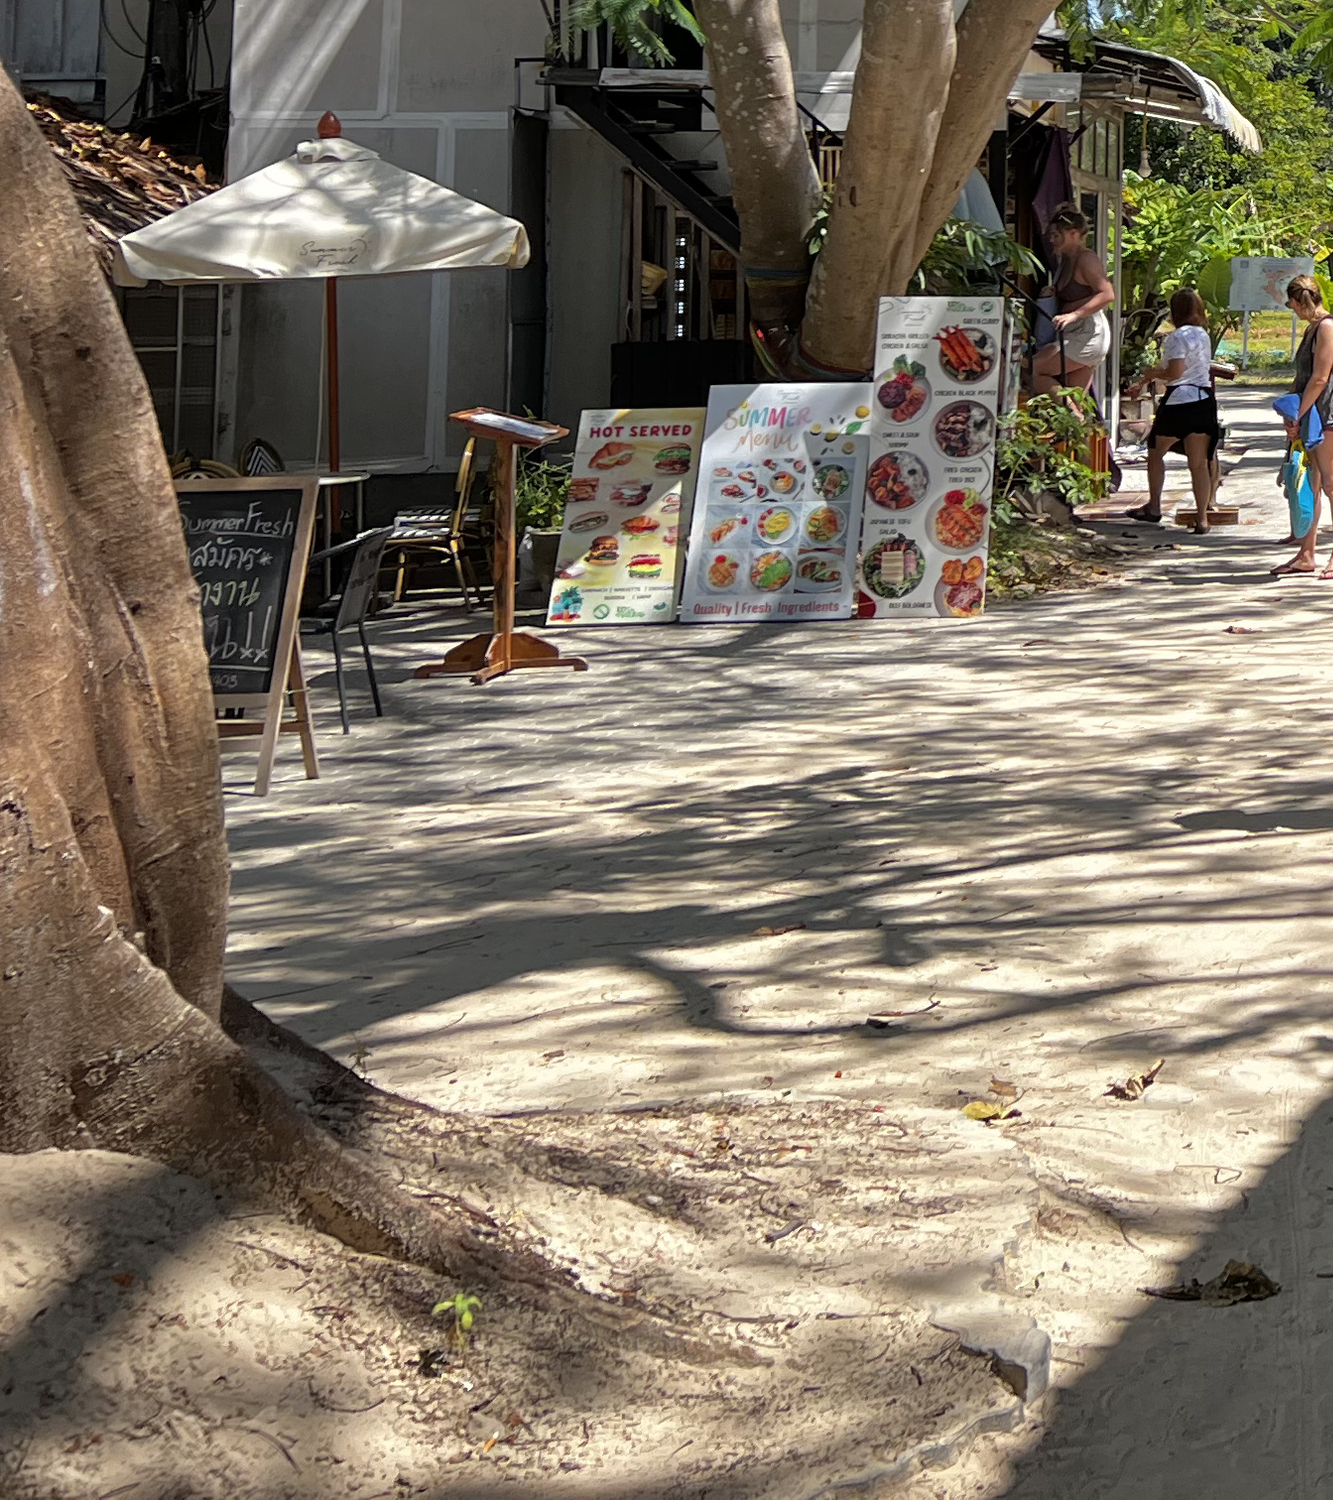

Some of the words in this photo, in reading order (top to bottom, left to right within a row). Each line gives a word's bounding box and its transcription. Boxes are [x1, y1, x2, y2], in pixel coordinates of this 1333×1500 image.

[723, 406, 812, 431] SUMMER
[589, 426, 624, 438] HOT
[629, 424, 692, 437] SERVED
[693, 603, 732, 616] Quality
[741, 603, 771, 614] Fresh
